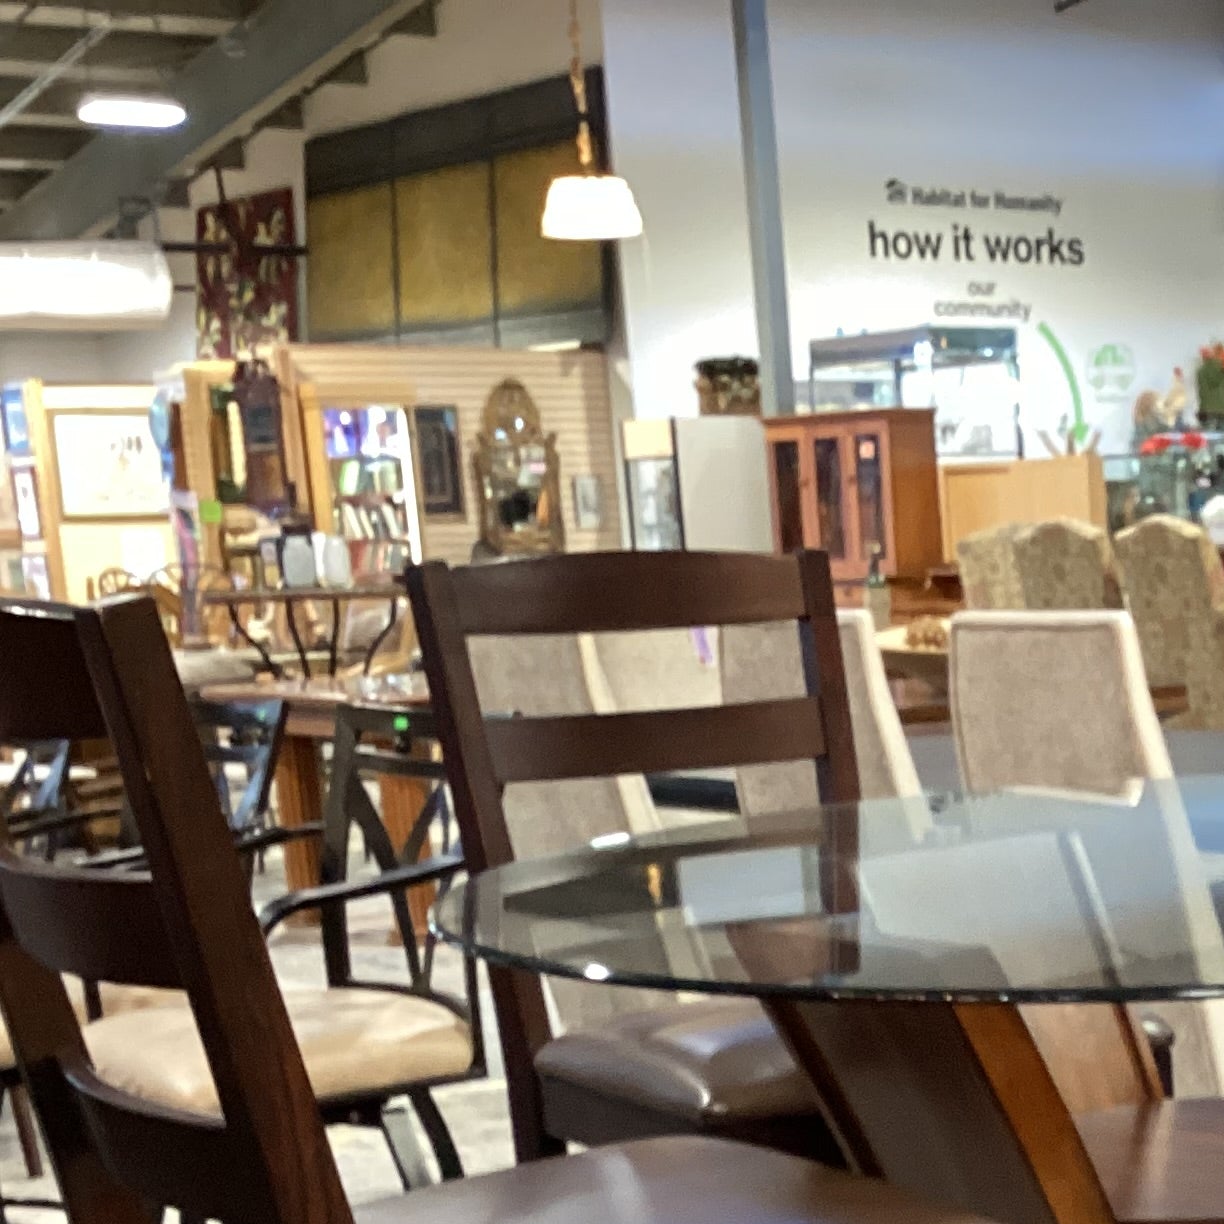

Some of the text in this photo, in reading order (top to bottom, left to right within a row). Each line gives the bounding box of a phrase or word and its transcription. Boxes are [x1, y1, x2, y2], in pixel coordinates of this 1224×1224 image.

[867, 219, 1085, 266] how it works
[966, 281, 997, 297] our
[933, 297, 1032, 322] community
